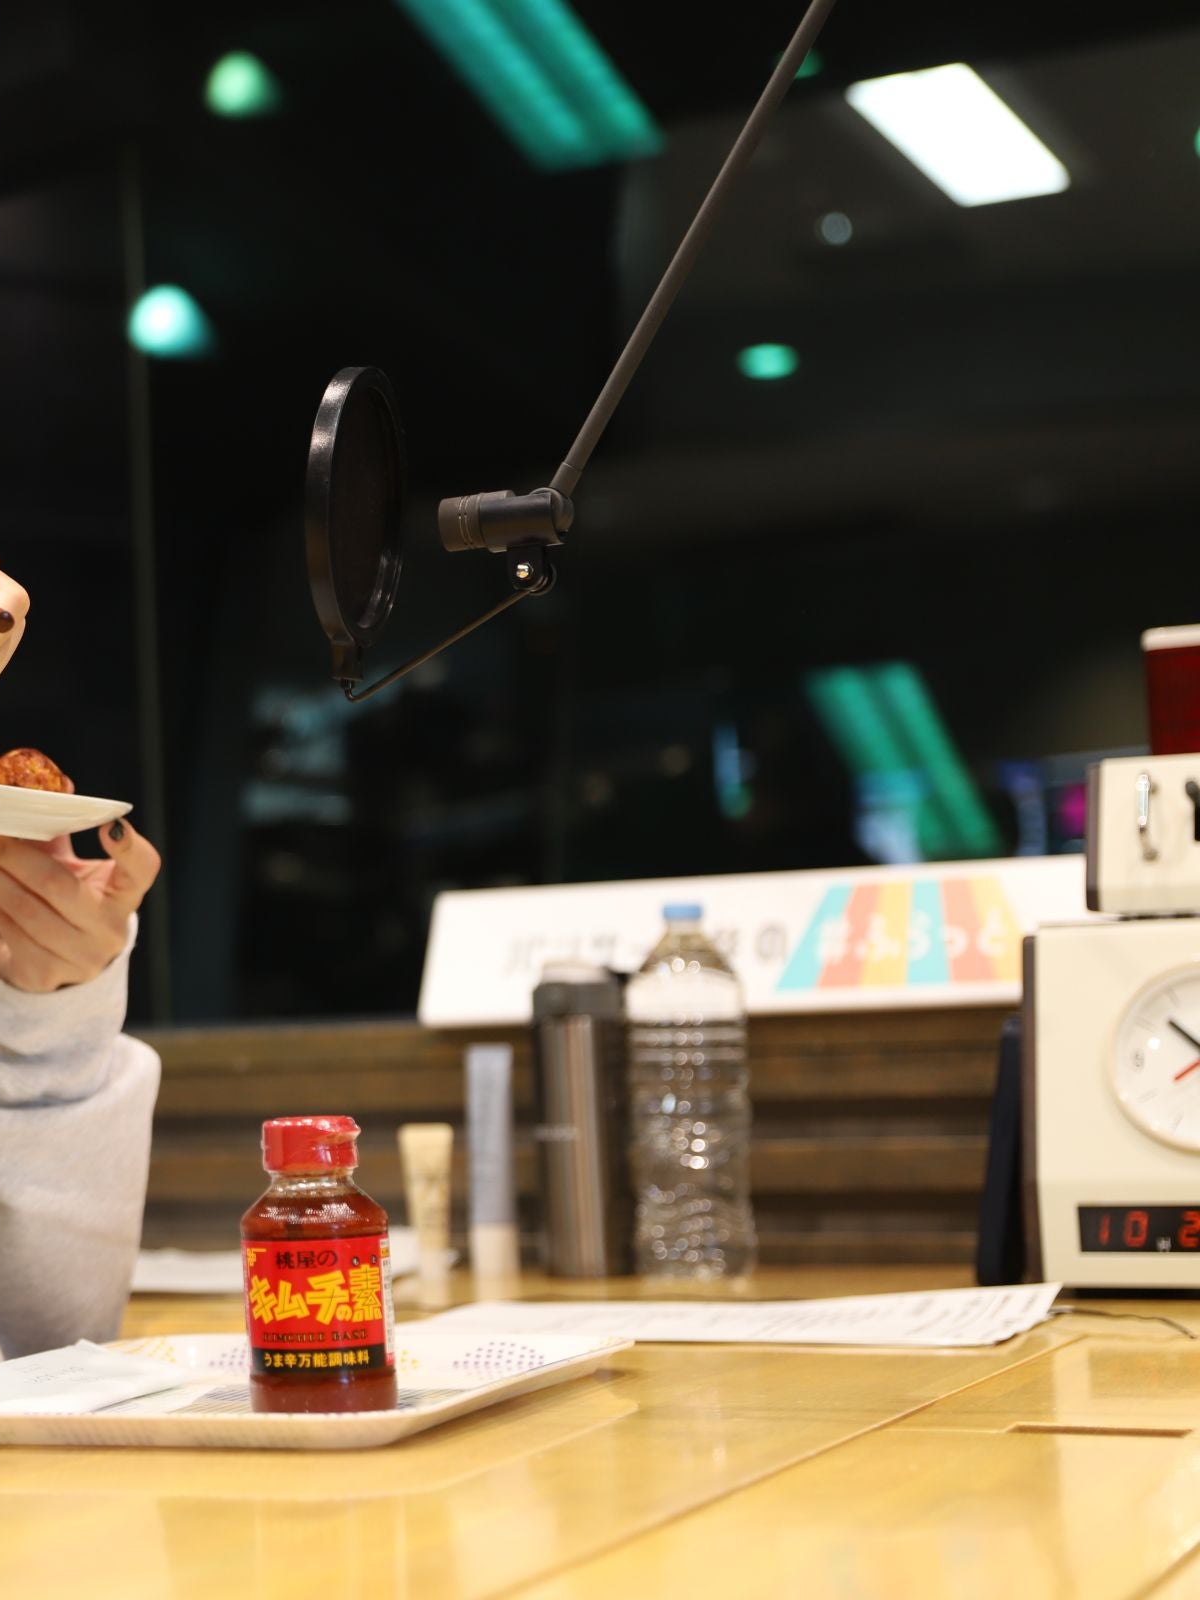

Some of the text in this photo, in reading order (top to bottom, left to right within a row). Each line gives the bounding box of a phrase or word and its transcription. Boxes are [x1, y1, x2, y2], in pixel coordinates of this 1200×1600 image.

[1098, 1210, 1150, 1248] 10
[275, 1250, 338, 1270] 桃屋の
[249, 1264, 383, 1326] キムチの素
[331, 1329, 368, 1342] BASE
[264, 1349, 370, 1369] うま辛万能調味料
